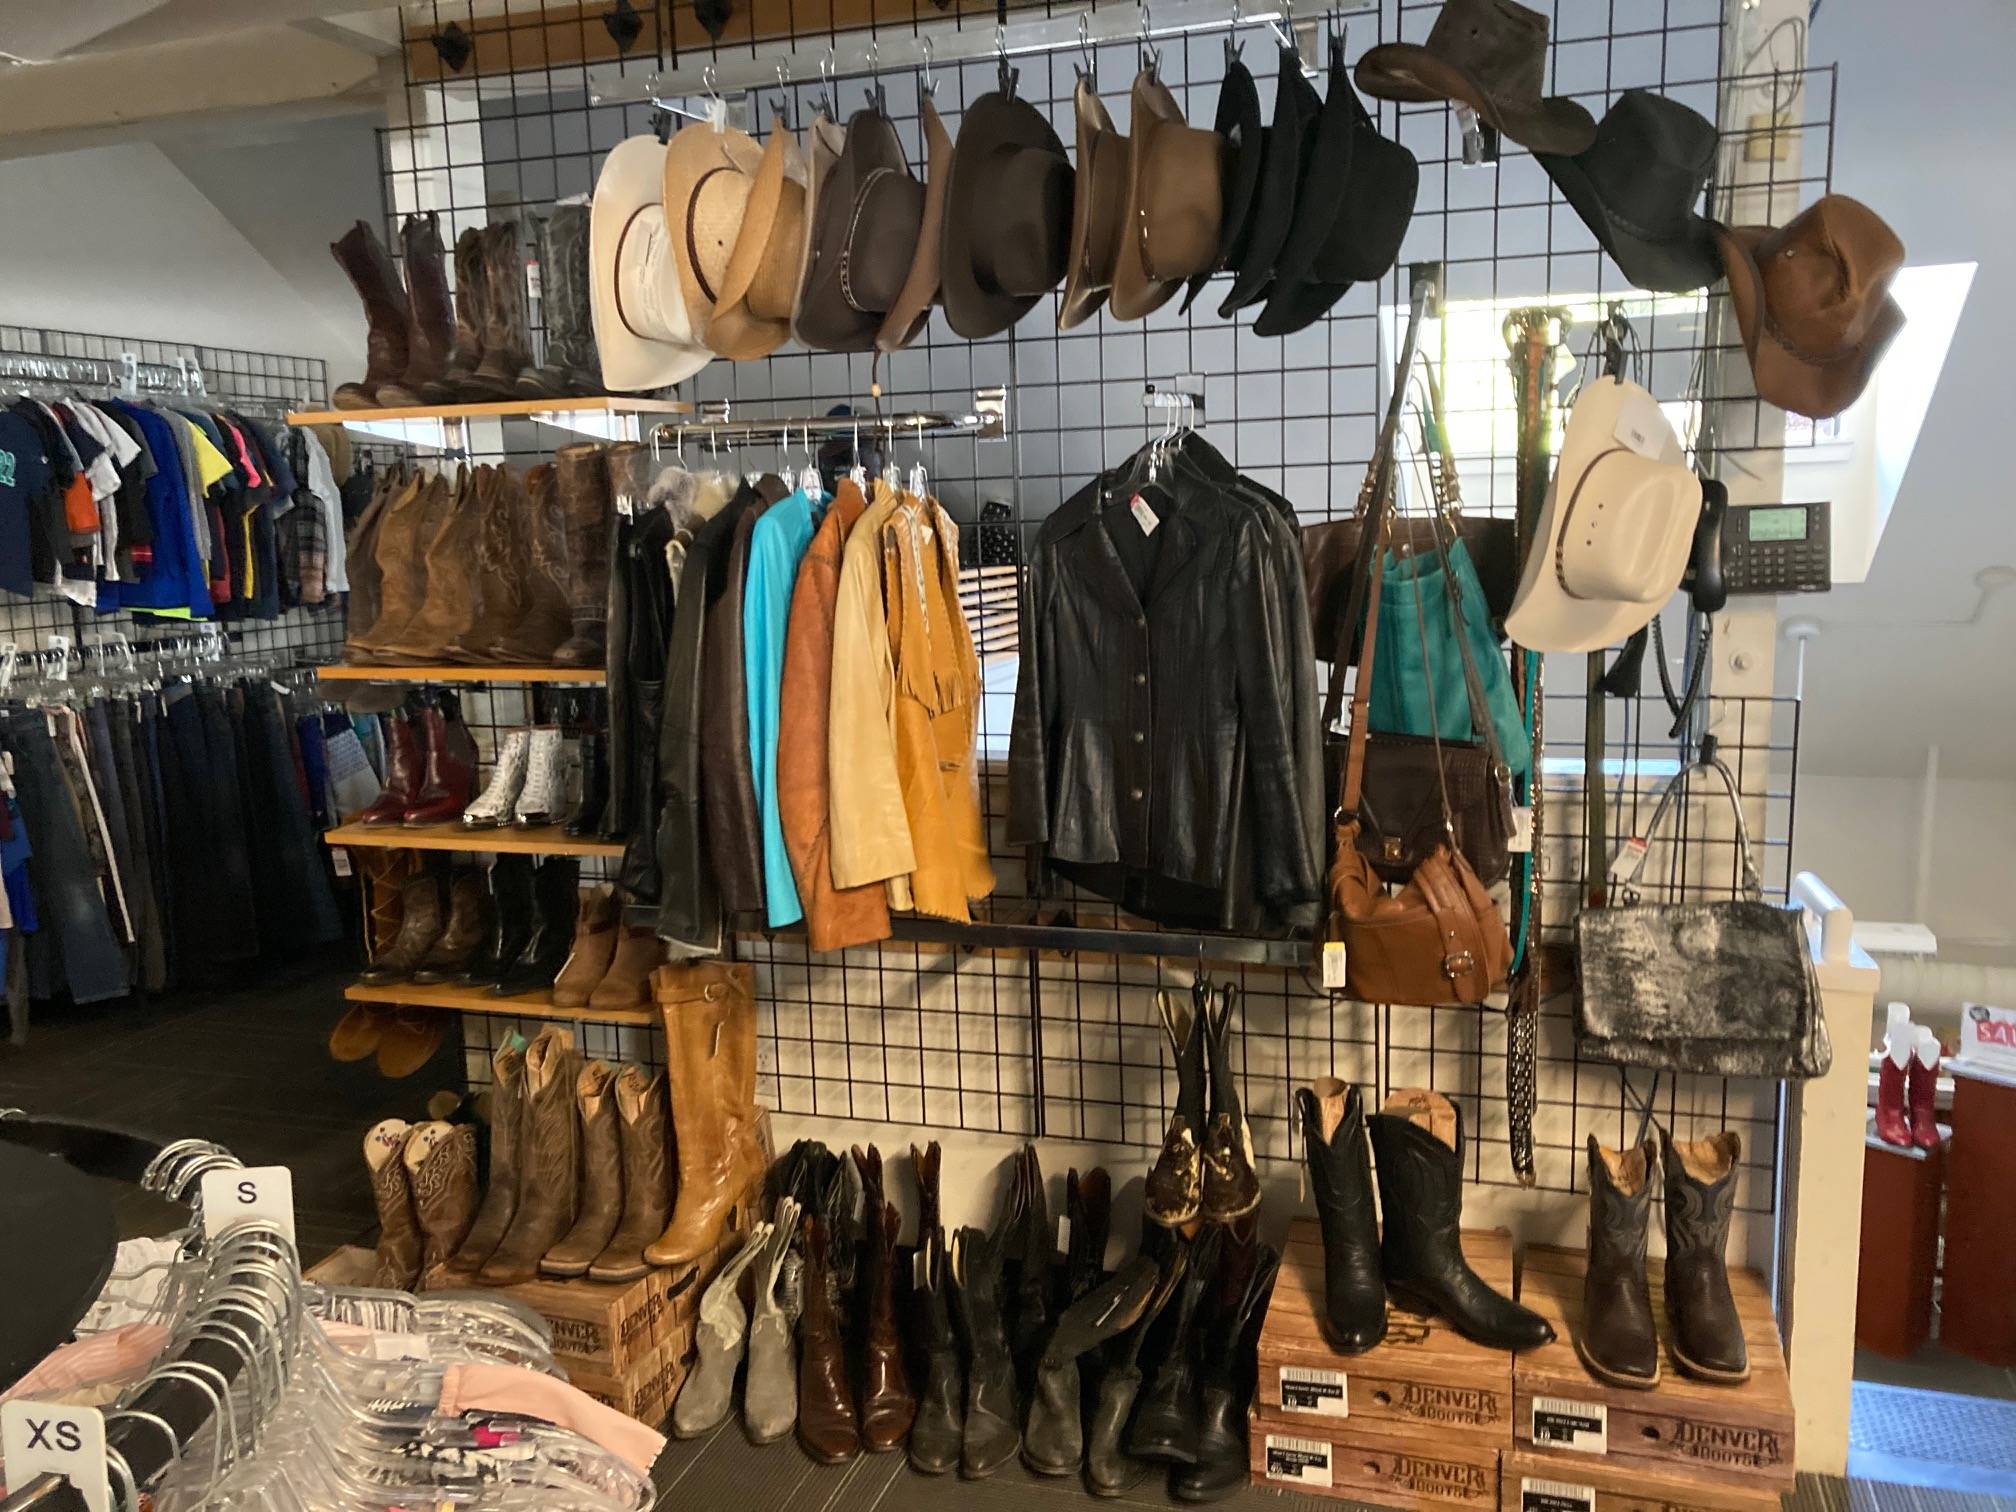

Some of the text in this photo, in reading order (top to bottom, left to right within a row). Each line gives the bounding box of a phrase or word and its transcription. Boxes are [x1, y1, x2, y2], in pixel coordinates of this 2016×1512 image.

[237, 1181, 258, 1204] S
[1403, 1382, 1498, 1414] DENVER
[1426, 1406, 1475, 1425] BOOTS
[25, 1418, 82, 1452] XS
[1674, 1420, 1780, 1459] DENVER
[1700, 1446, 1753, 1467] BOOTS
[1393, 1456, 1487, 1490] DENVER
[1415, 1480, 1463, 1498] BOOTS
